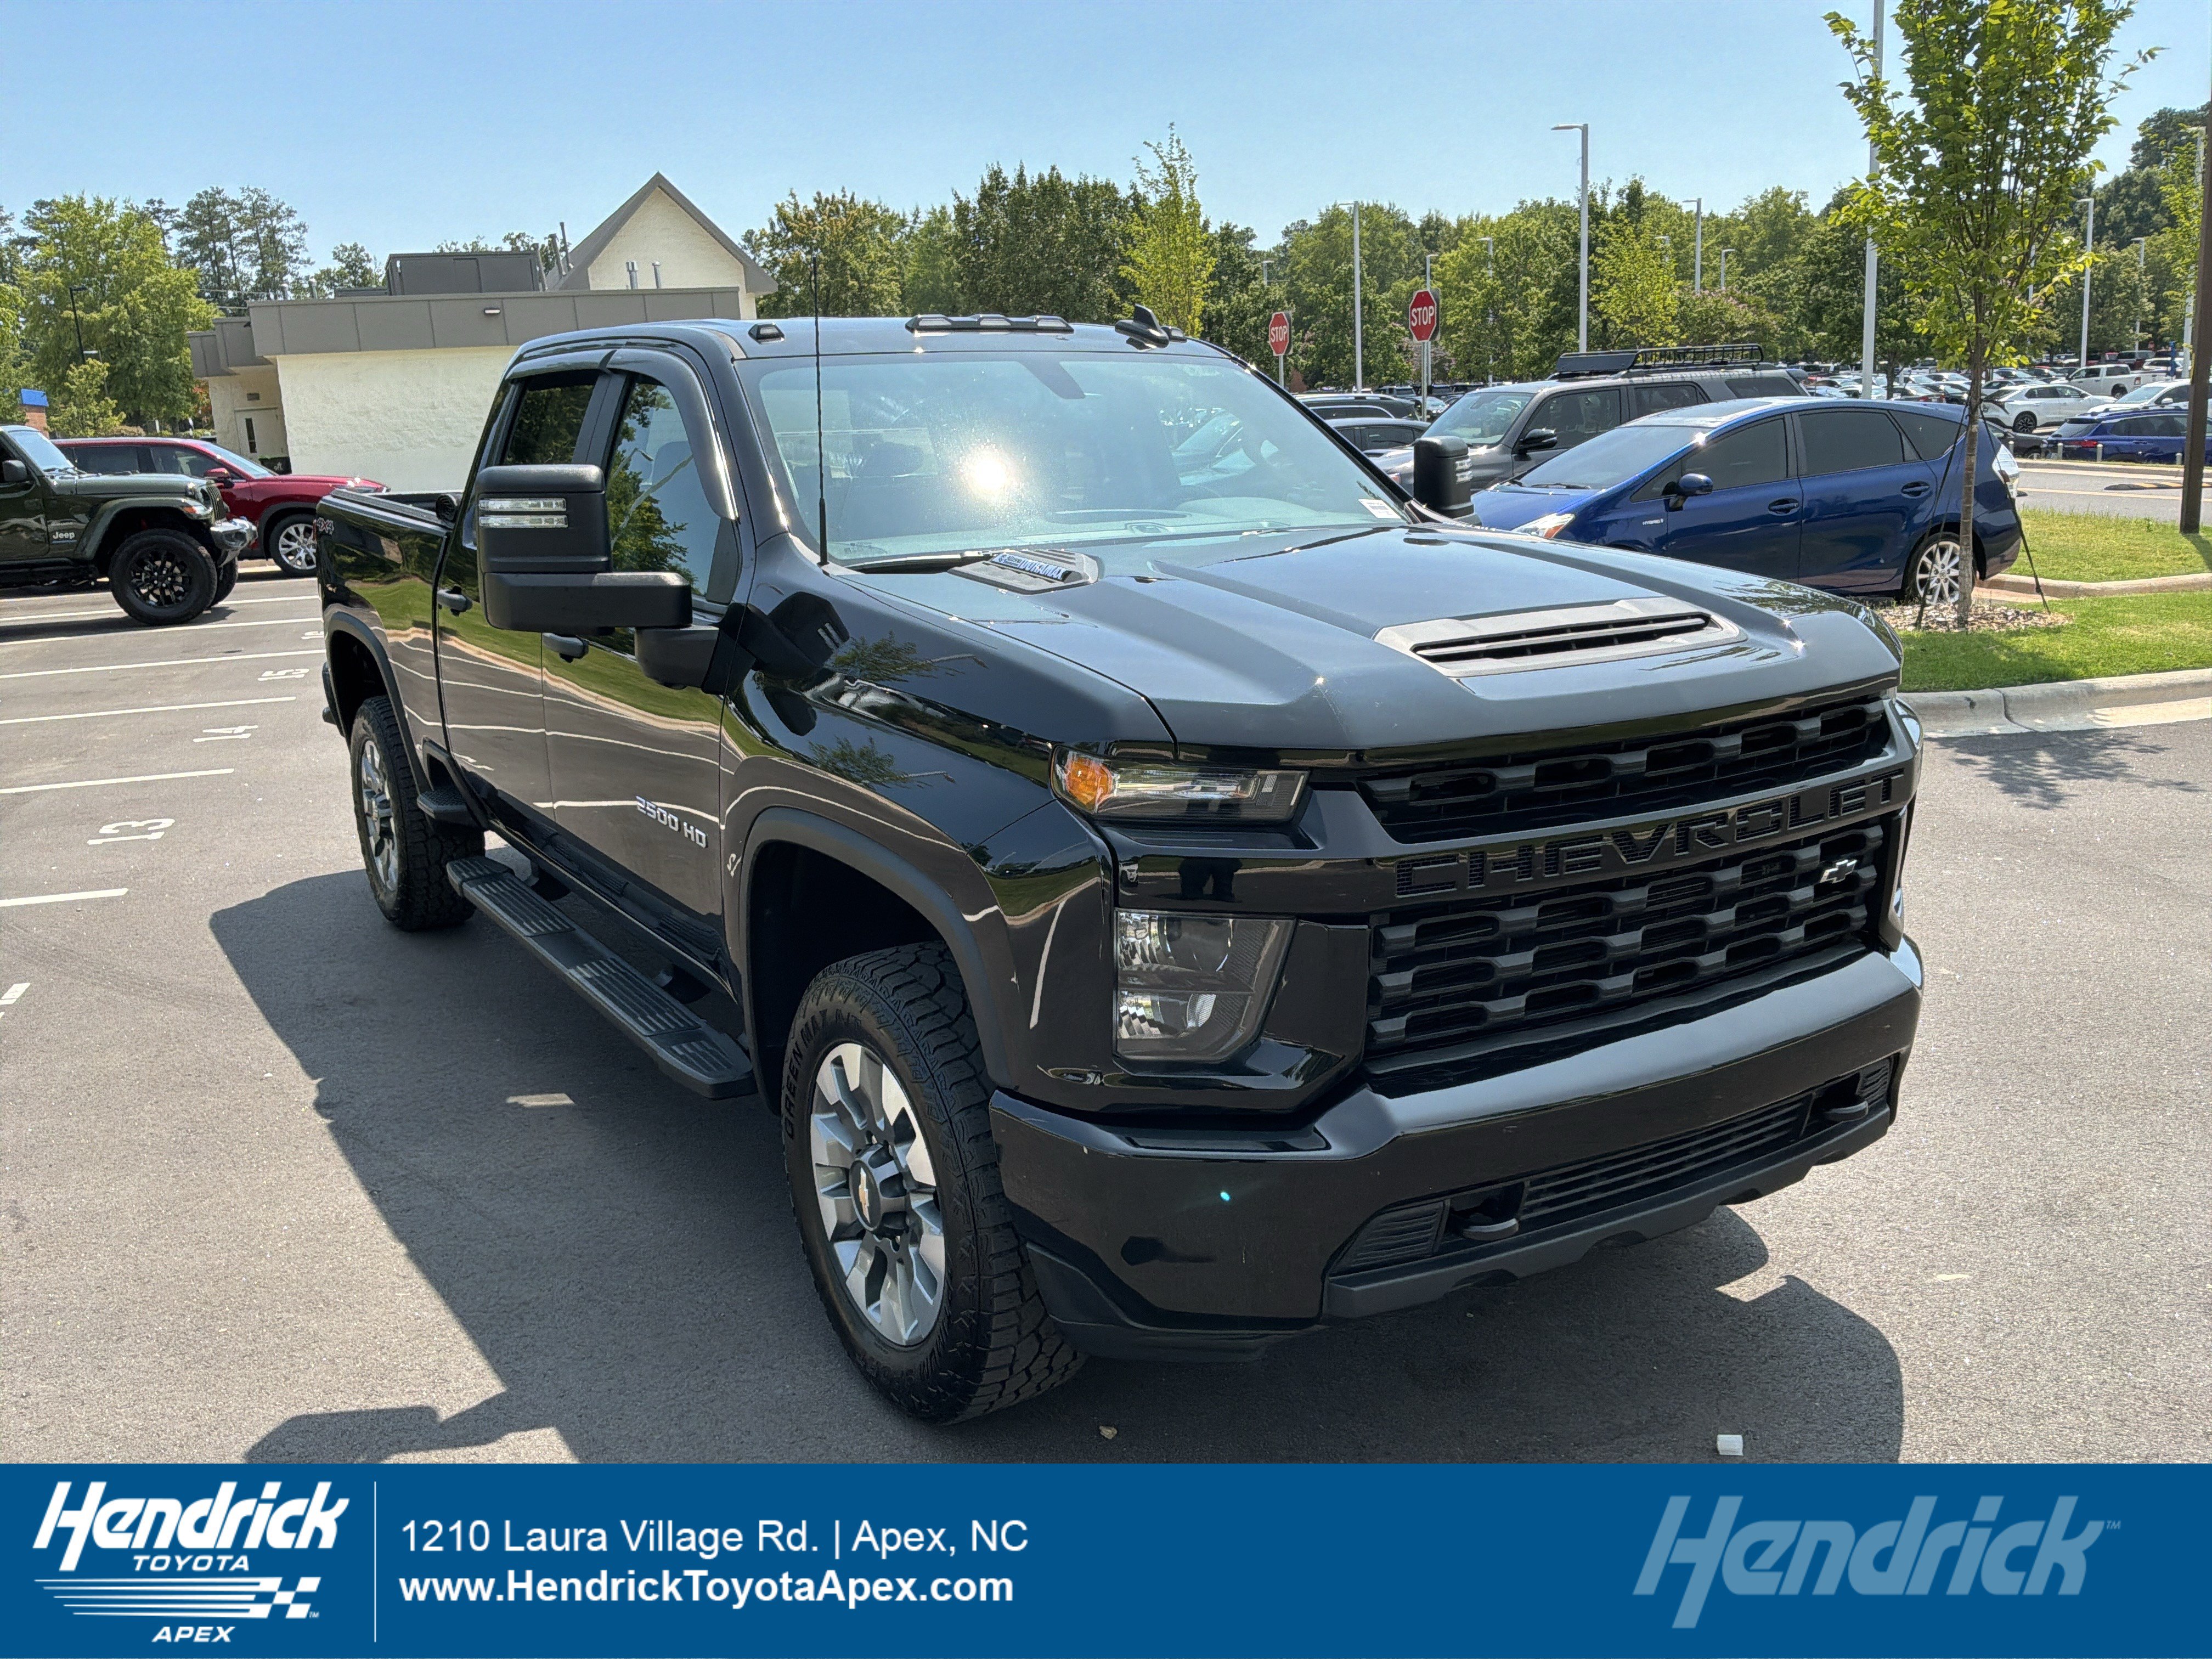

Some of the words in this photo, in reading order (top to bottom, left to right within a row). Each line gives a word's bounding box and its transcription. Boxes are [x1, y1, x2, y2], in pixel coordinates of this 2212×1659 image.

[1410, 305, 1435, 327] STOP
[1270, 326, 1288, 342] STOP
[53, 531, 75, 539] Jeep
[258, 669, 309, 681] 15
[193, 725, 259, 742] 14
[635, 795, 680, 832] 2500
[683, 821, 709, 848] HD
[87, 818, 175, 845] 13
[1395, 768, 1904, 898] CHEVROLET
